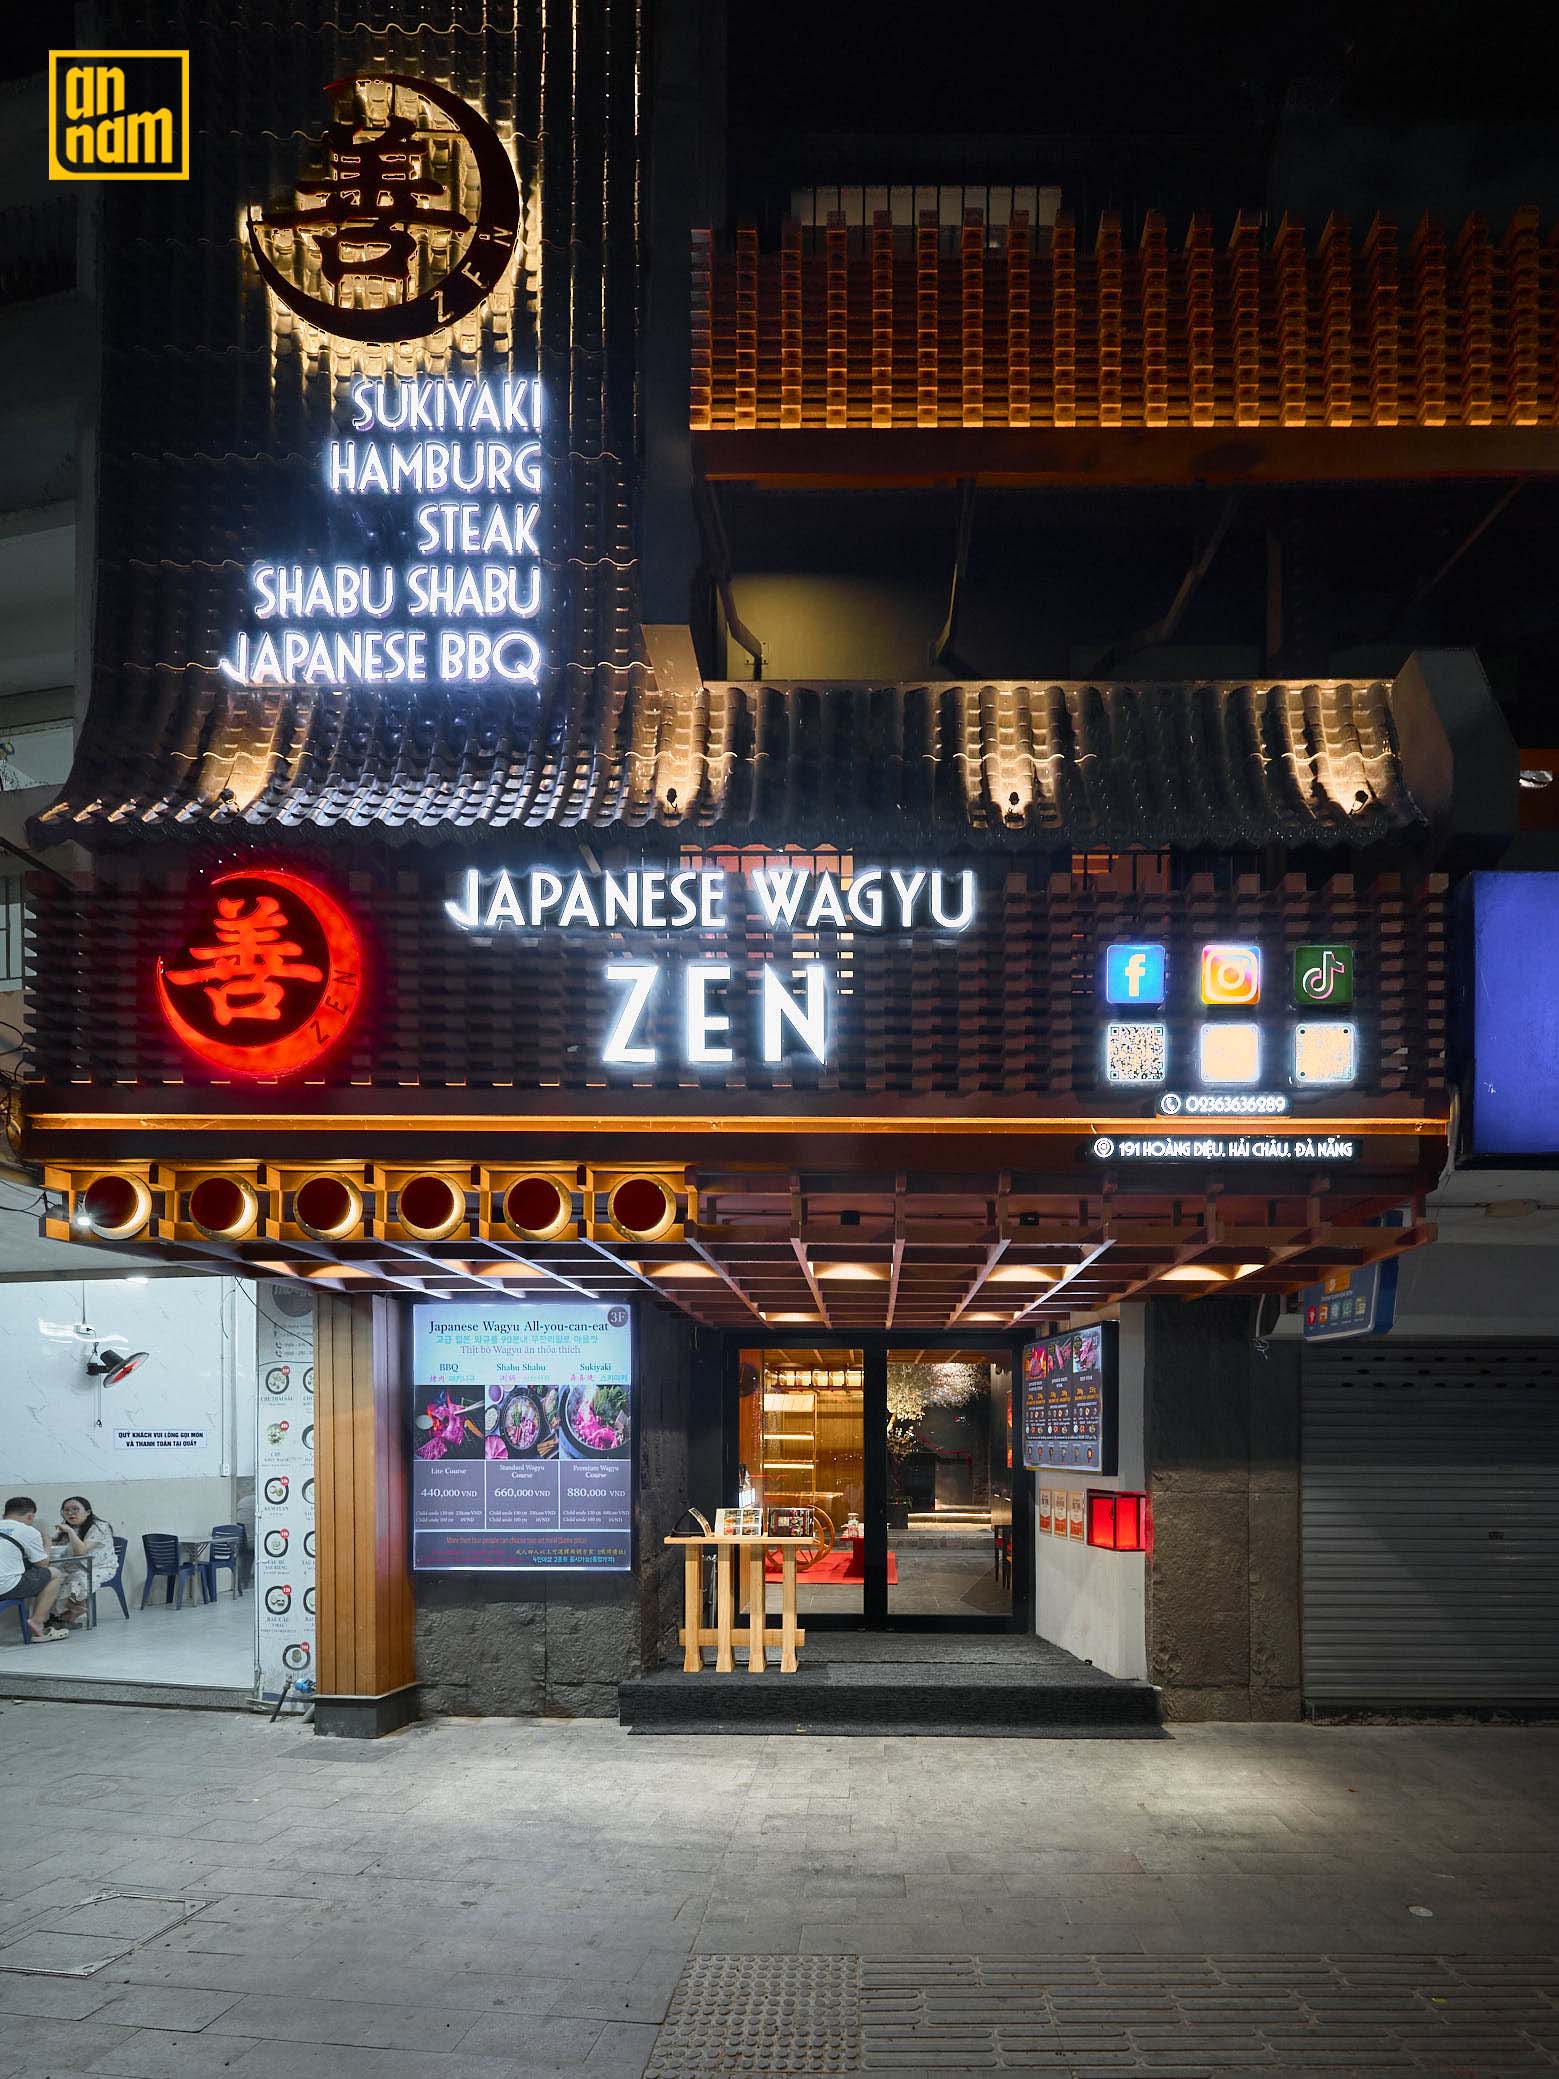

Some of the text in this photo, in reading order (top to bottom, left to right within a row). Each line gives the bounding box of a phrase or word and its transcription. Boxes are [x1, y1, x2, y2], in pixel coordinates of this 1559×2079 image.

[431, 226, 513, 323] ZEN
[352, 379, 543, 431] SUKIYAKI
[330, 441, 542, 493] HAMBURG
[417, 503, 541, 554] STEAK
[254, 566, 541, 617] SHABU SHABU
[219, 632, 541, 684] JAPANESE BBQ
[444, 868, 975, 930] JAPANESE WAGYU
[165, 896, 323, 1026] 善
[309, 970, 357, 1045] ZEN
[603, 965, 827, 1065] ZEN
[1119, 1141, 1140, 1157] 191
[1294, 1138, 1315, 1157] ĐÀ
[610, 1311, 626, 1323] 3F
[429, 1321, 609, 1334] Japanese Wagyu All-you-can-eat
[493, 1346, 521, 1356] Wagyu
[439, 1363, 459, 1373] BBQ
[496, 1363, 546, 1371] Shabu Shabu
[579, 1363, 612, 1373] Sukiyaki
[445, 1467, 467, 1475] Course
[421, 1488, 477, 1499] 440,000 VND
[494, 1488, 551, 1499] 660,000 VND
[567, 1488, 626, 1498] 880,000 VND
